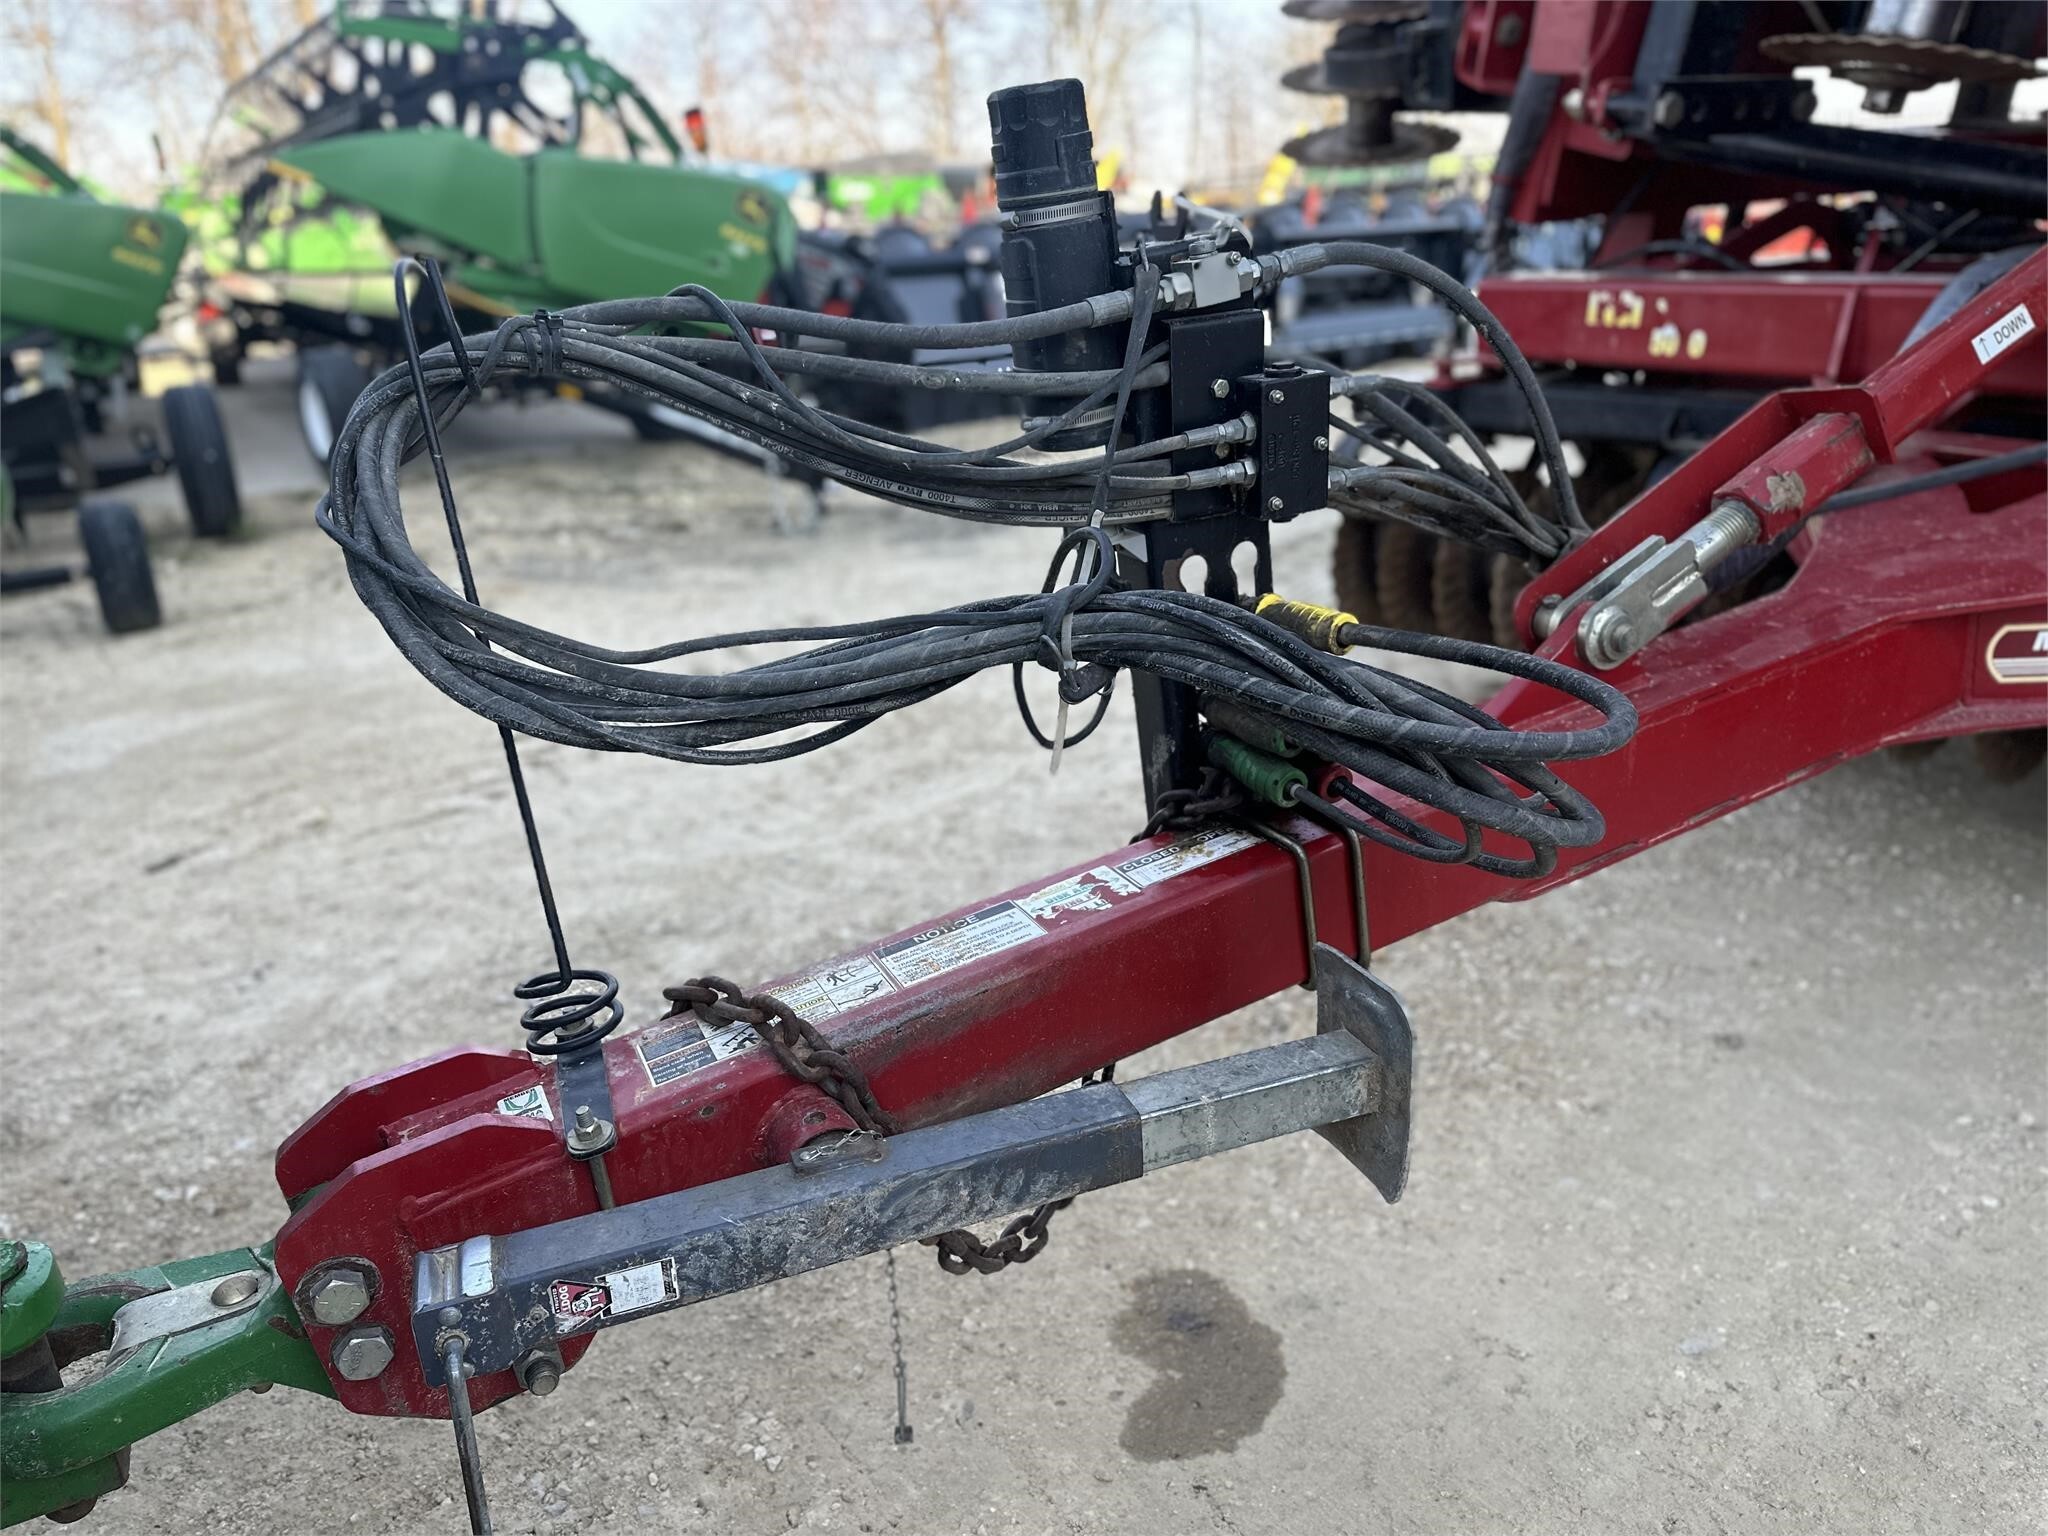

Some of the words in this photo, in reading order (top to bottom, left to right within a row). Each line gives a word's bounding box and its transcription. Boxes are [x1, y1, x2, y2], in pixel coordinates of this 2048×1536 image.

[1993, 313, 2027, 344] DOWN
[843, 469, 893, 489] AVENGER
[927, 491, 956, 503] T4000
[1122, 843, 1180, 874] CLOSED
[548, 1287, 562, 1309] TRUSTED
